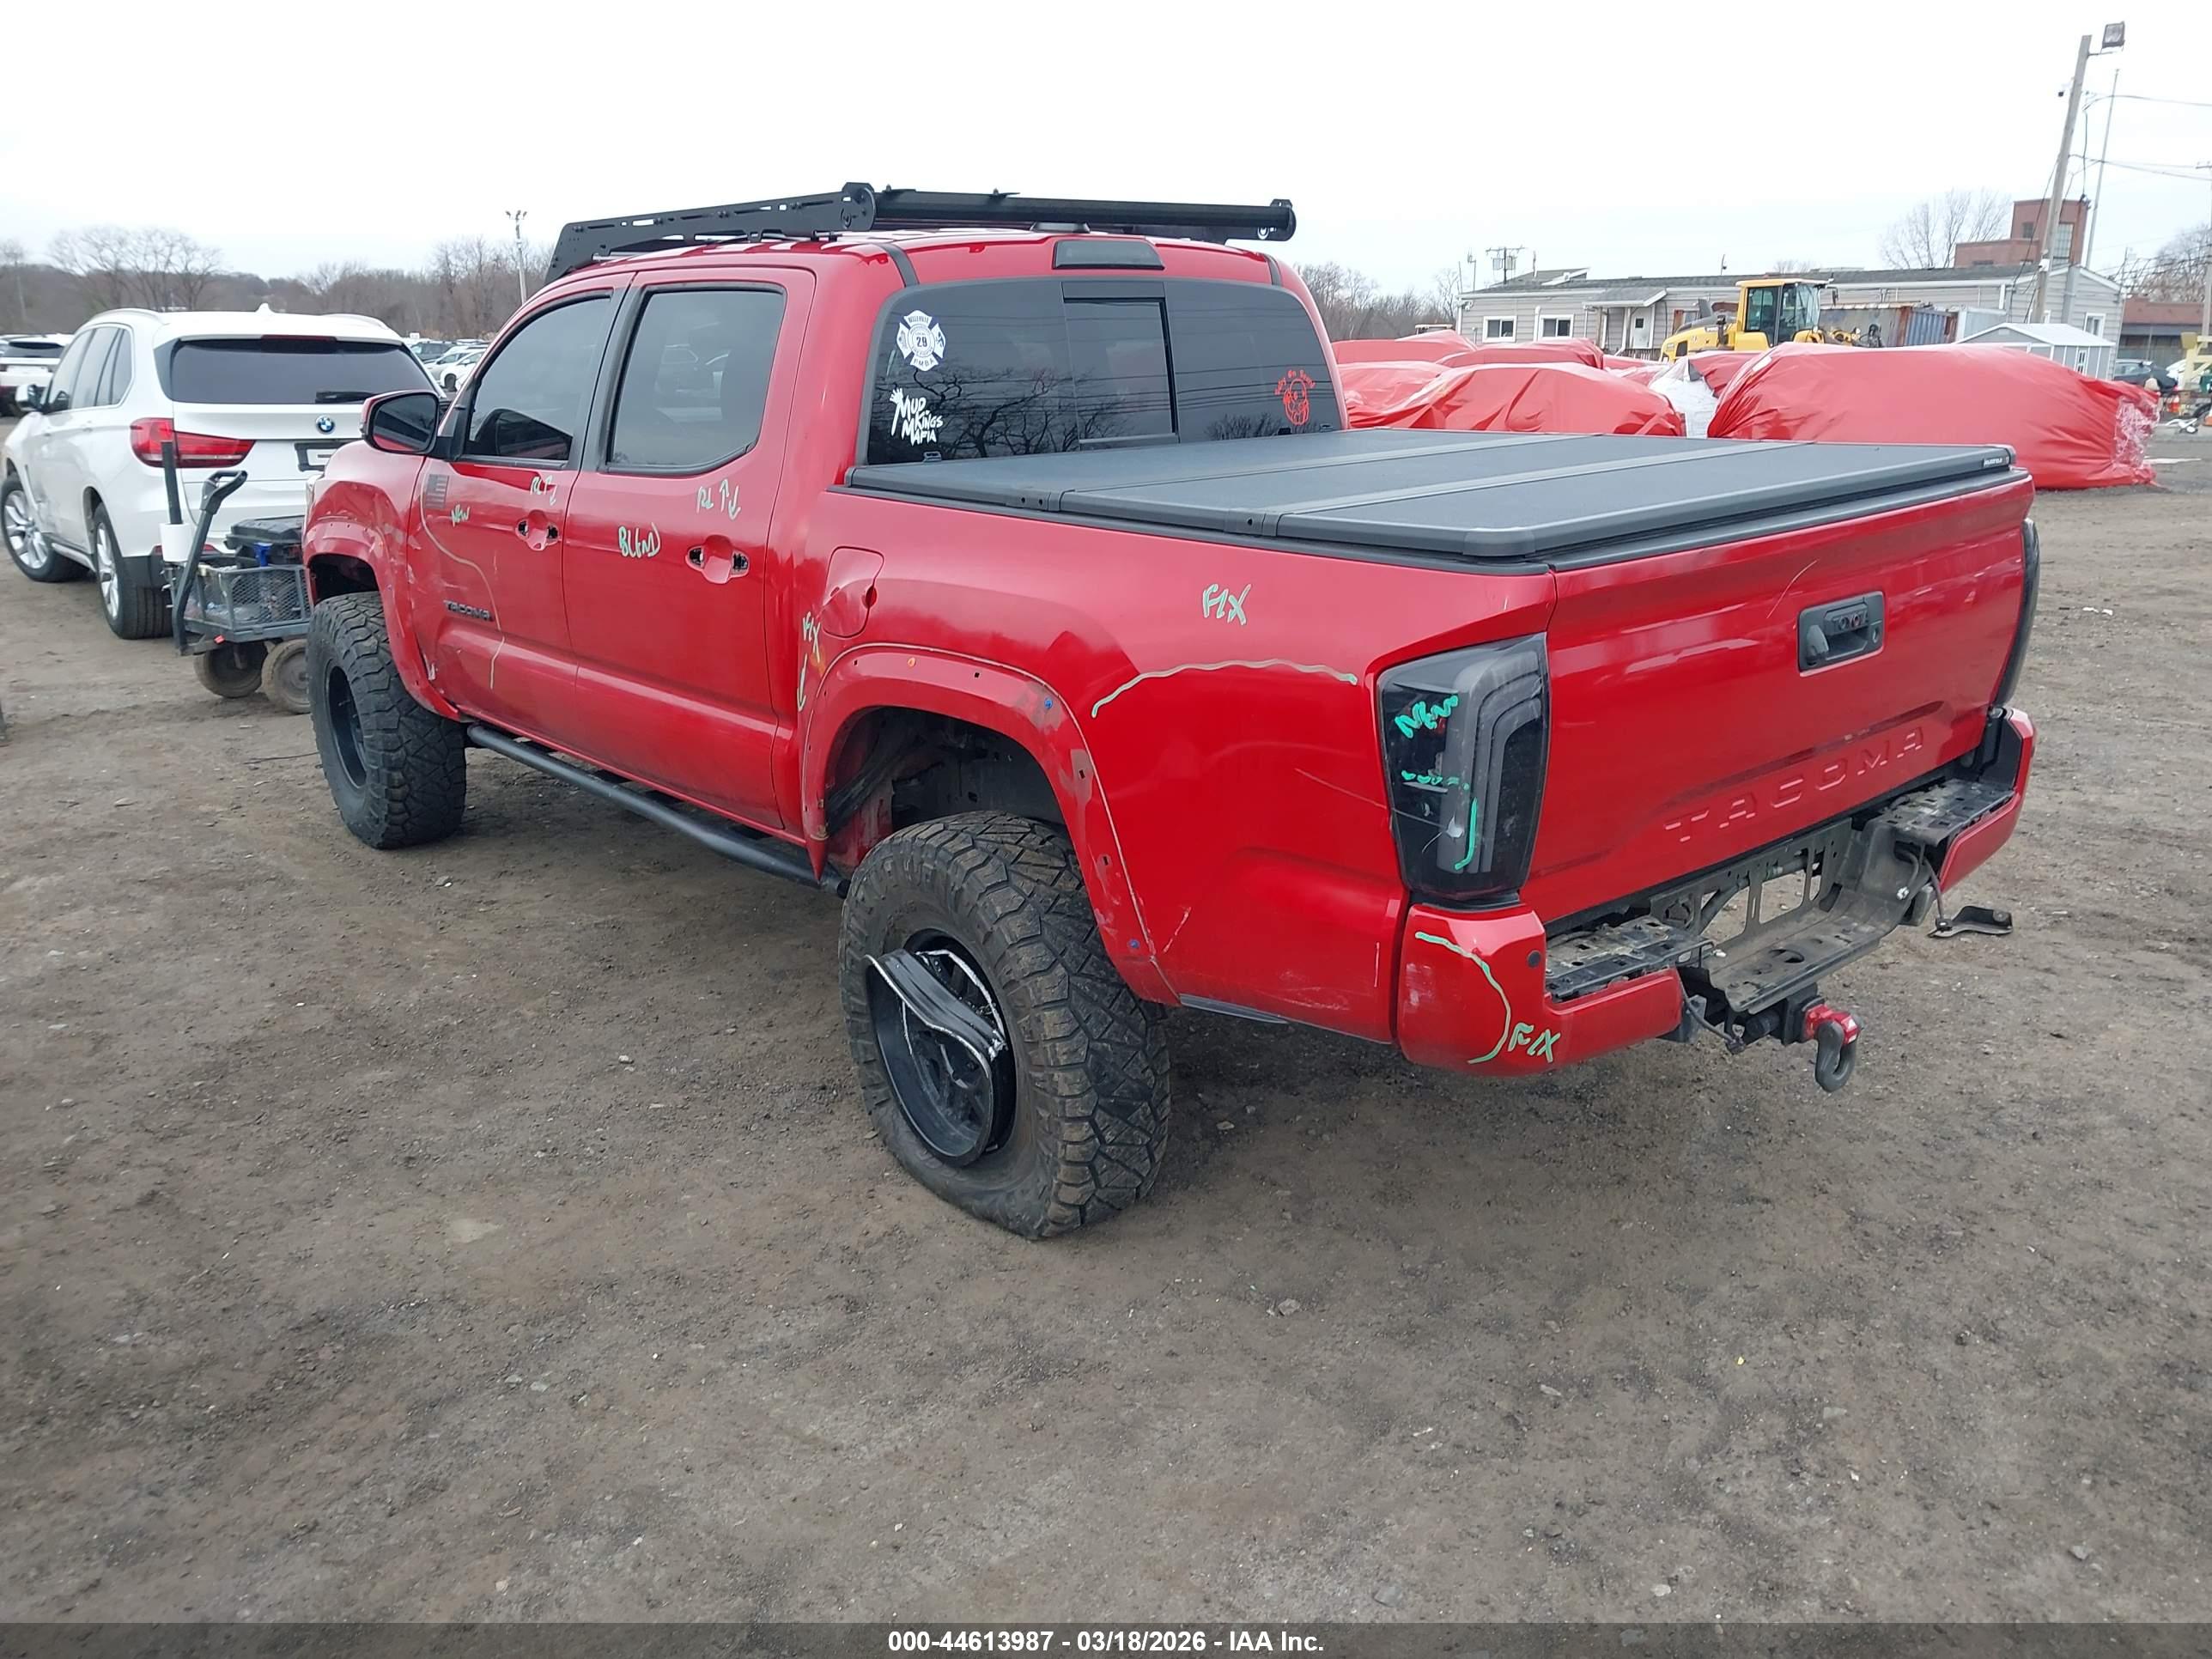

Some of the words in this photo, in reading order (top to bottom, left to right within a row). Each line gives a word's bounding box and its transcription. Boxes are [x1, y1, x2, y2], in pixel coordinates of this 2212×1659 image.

[916, 337, 927, 348] 29
[890, 388, 927, 436] MUD
[901, 417, 937, 447] MAFIA
[443, 599, 495, 622] TACOMA
[1202, 583, 1251, 626] FIX
[1663, 726, 1924, 843] TACOMA
[1507, 1022, 1561, 1063] FIX
